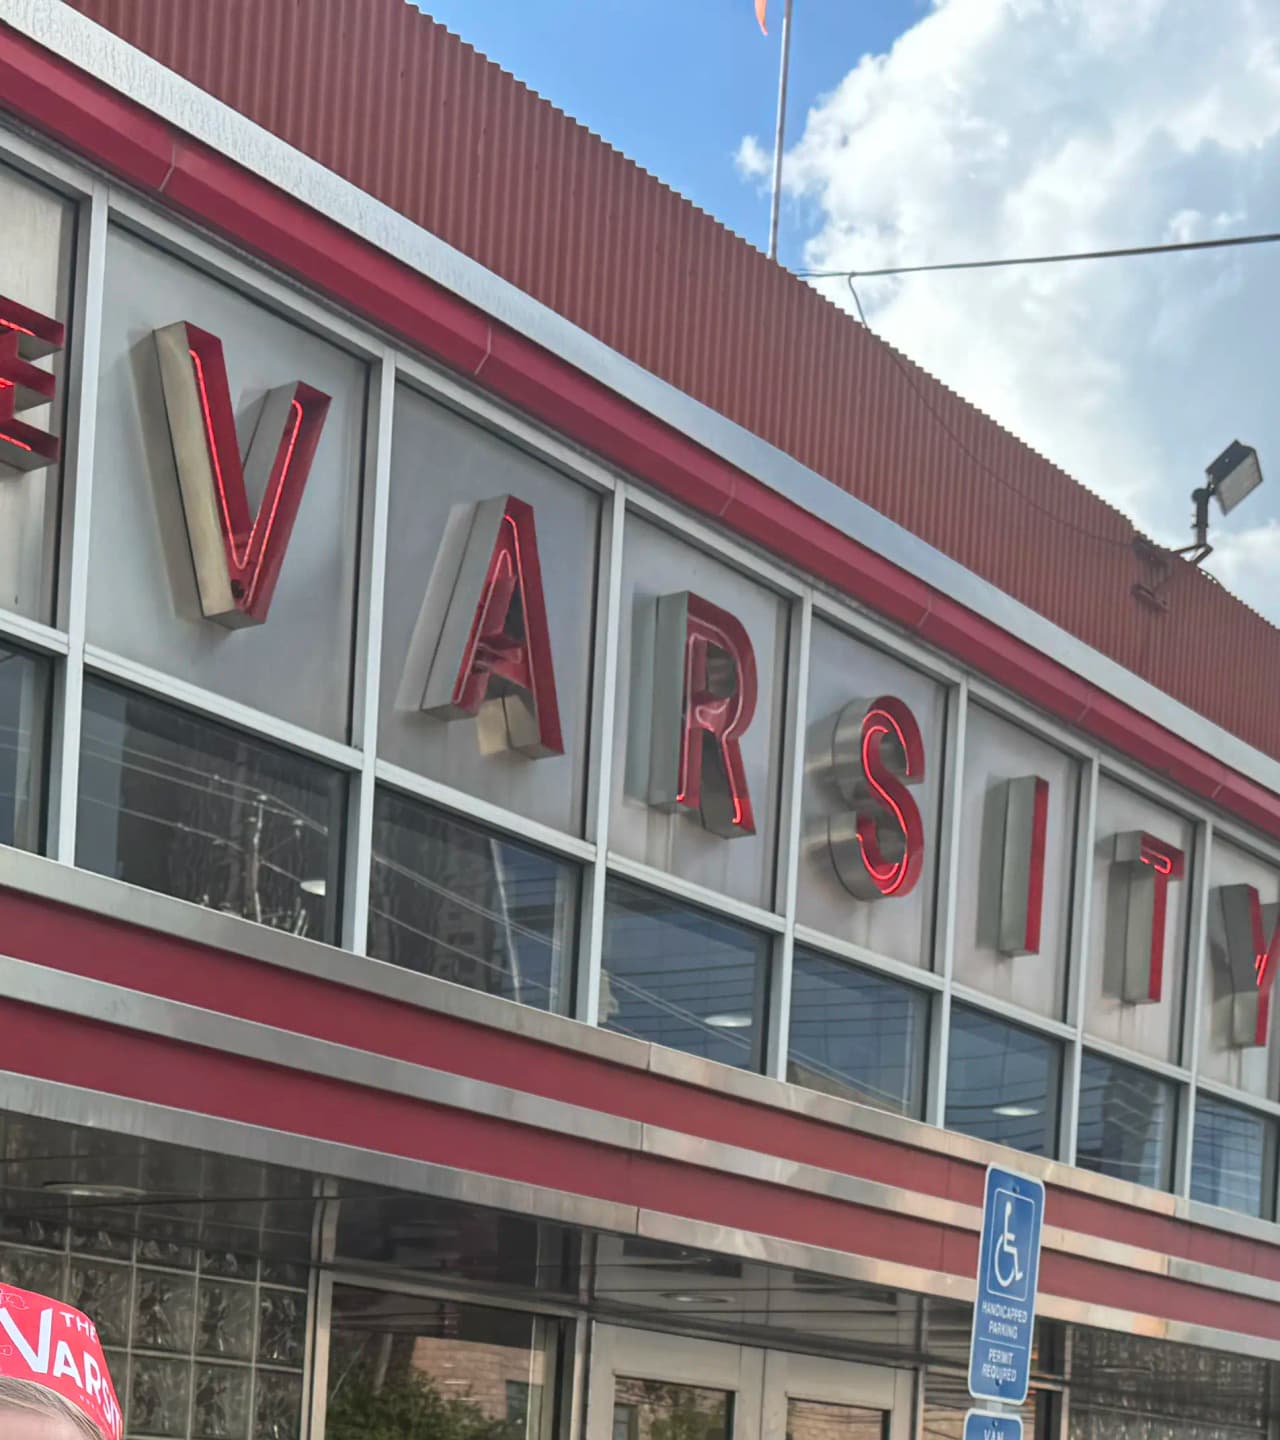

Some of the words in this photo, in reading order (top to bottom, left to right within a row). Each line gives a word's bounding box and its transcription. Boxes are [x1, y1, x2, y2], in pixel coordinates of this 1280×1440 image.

[982, 1300, 1028, 1324] HANDICAPPED
[59, 1311, 97, 1343] THE
[988, 1320, 1018, 1339] PARKING
[988, 1348, 1014, 1365] PERMIT
[981, 1363, 1017, 1382] REQUIRED
